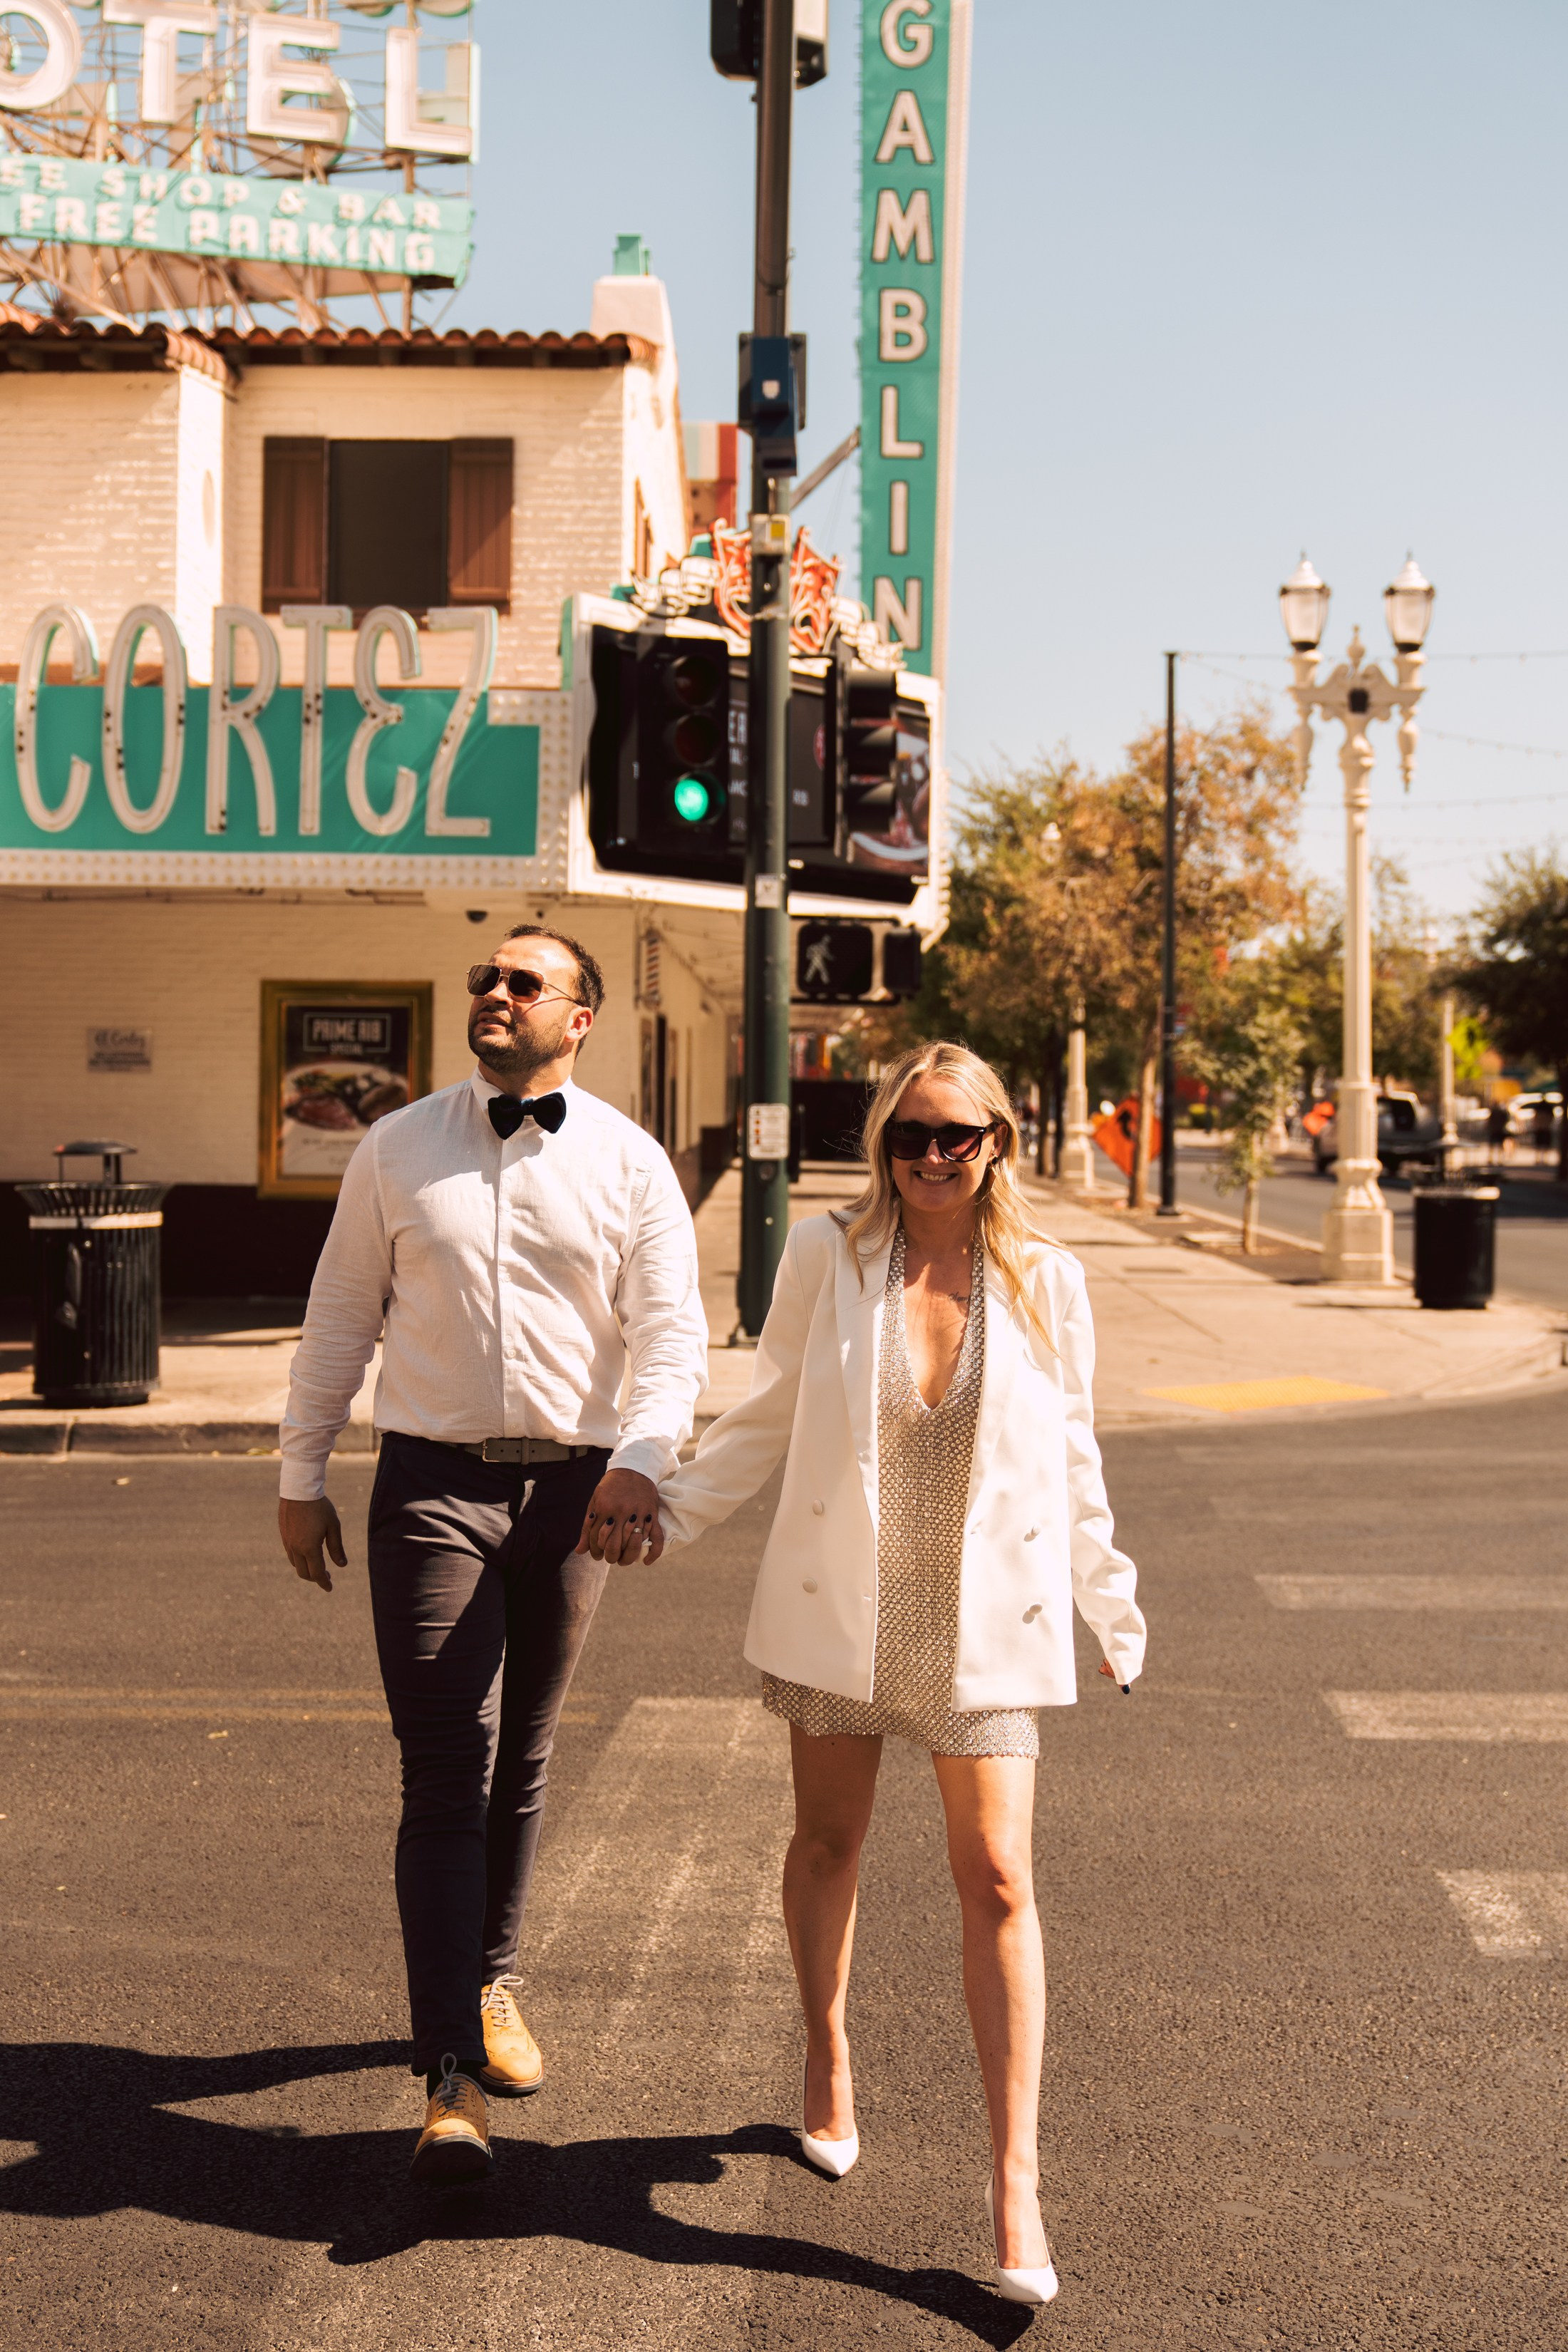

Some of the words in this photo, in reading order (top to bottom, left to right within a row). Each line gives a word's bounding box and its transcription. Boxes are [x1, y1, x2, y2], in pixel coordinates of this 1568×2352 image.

[19, 193, 159, 243] FREE
[189, 210, 435, 270] PARKING
[101, 167, 249, 207] SHOP
[277, 187, 307, 214] &
[338, 193, 440, 229] BAR
[14, 603, 497, 837] CORTEZ
[312, 1018, 356, 1042] PRIME
[358, 1018, 382, 1043] RIB
